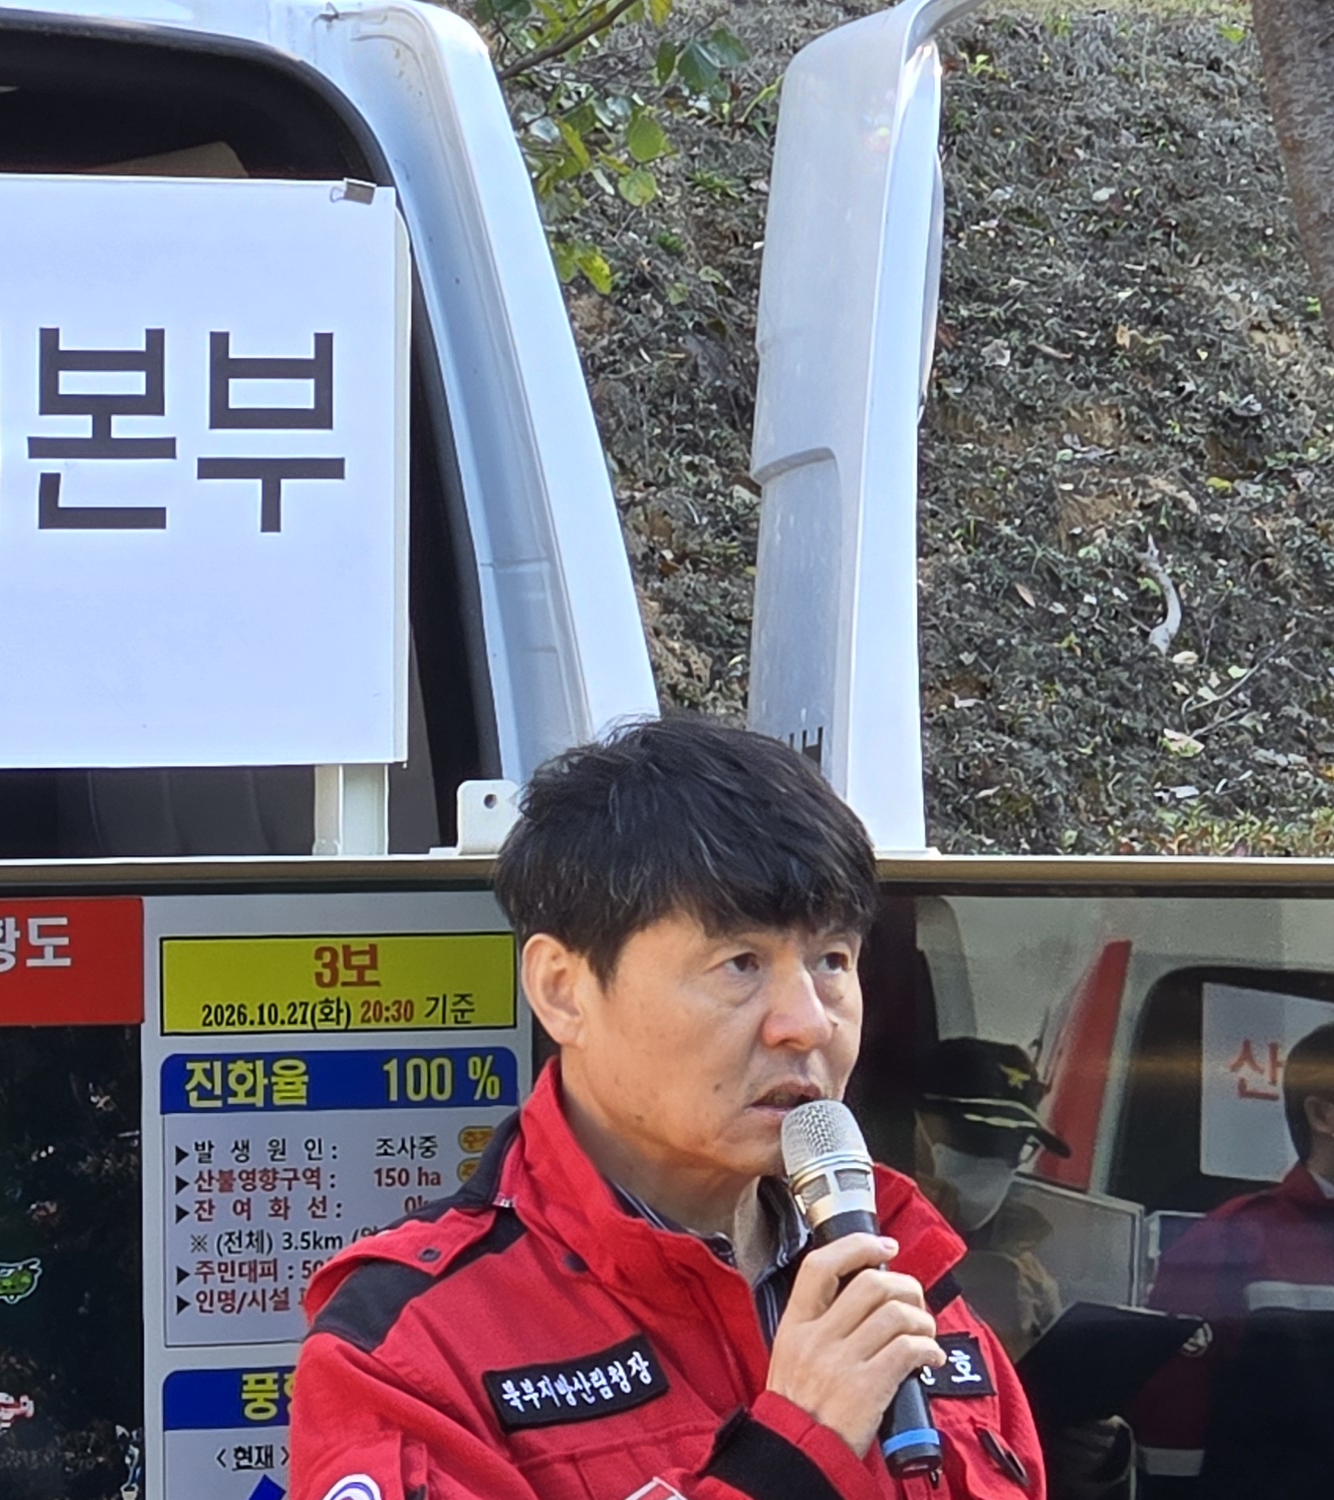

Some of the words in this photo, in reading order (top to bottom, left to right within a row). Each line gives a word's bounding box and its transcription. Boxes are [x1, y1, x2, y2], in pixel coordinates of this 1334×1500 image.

[313, 943, 381, 989] 3보
[202, 997, 352, 1030] 2026.10.27(화)
[360, 999, 415, 1024] 20:30
[423, 993, 475, 1026] 기준
[184, 1056, 310, 1108] 진화율
[382, 1057, 453, 1102] 100
[468, 1054, 501, 1100] %
[375, 1135, 439, 1160] 조사중
[374, 1167, 410, 1188] 150
[417, 1167, 441, 1188] ha
[216, 1231, 273, 1258] (전체)
[282, 1229, 343, 1252] 3.5km
[196, 1286, 290, 1315] 인명/시설
[502, 1350, 652, 1413] 북부지방산림청장
